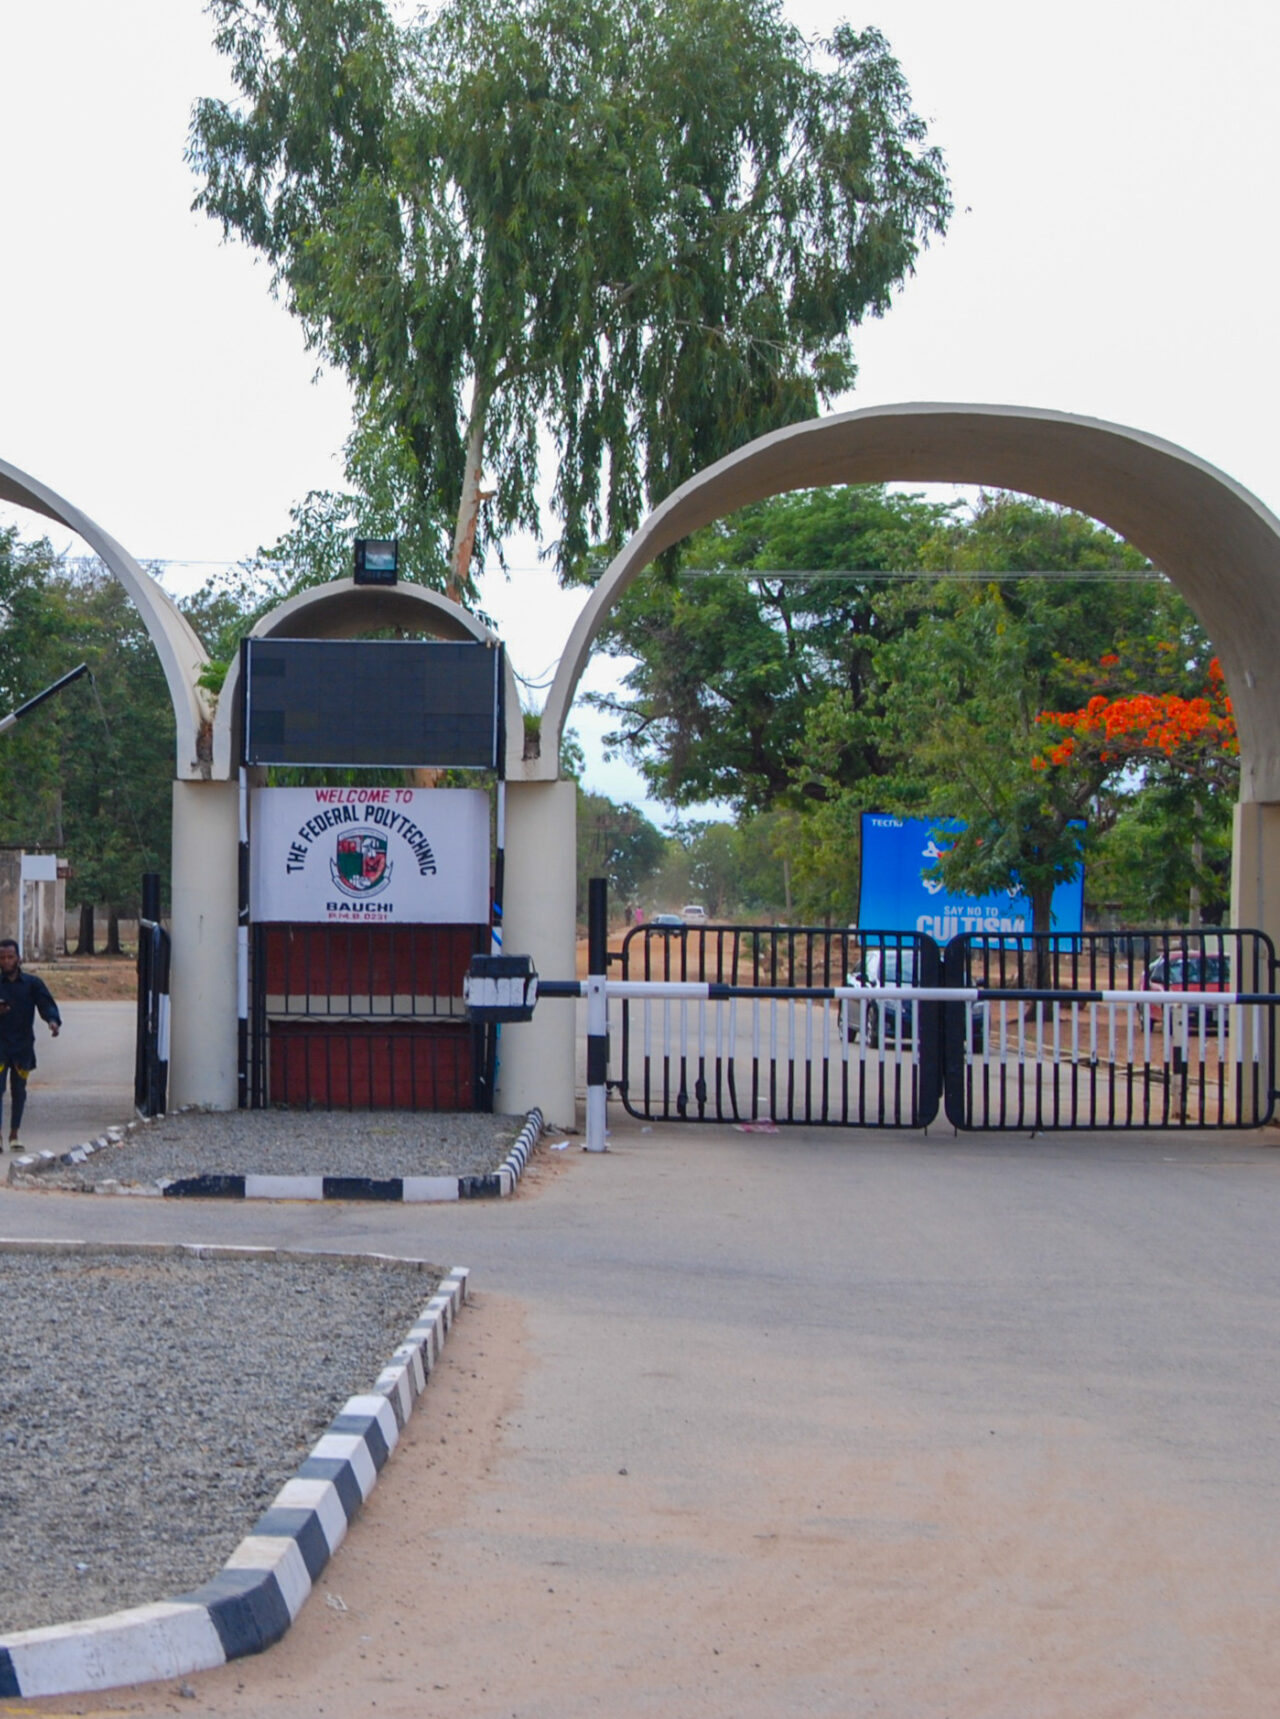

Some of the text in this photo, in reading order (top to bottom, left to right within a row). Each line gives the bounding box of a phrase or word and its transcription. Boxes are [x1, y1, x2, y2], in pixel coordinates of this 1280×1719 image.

[315, 789, 413, 804] WELCOME TO
[286, 804, 437, 876] THE FEDERAL POLYTECHNIC
[326, 902, 394, 912] BAUCHI
[944, 905, 999, 917] SAY NO TO
